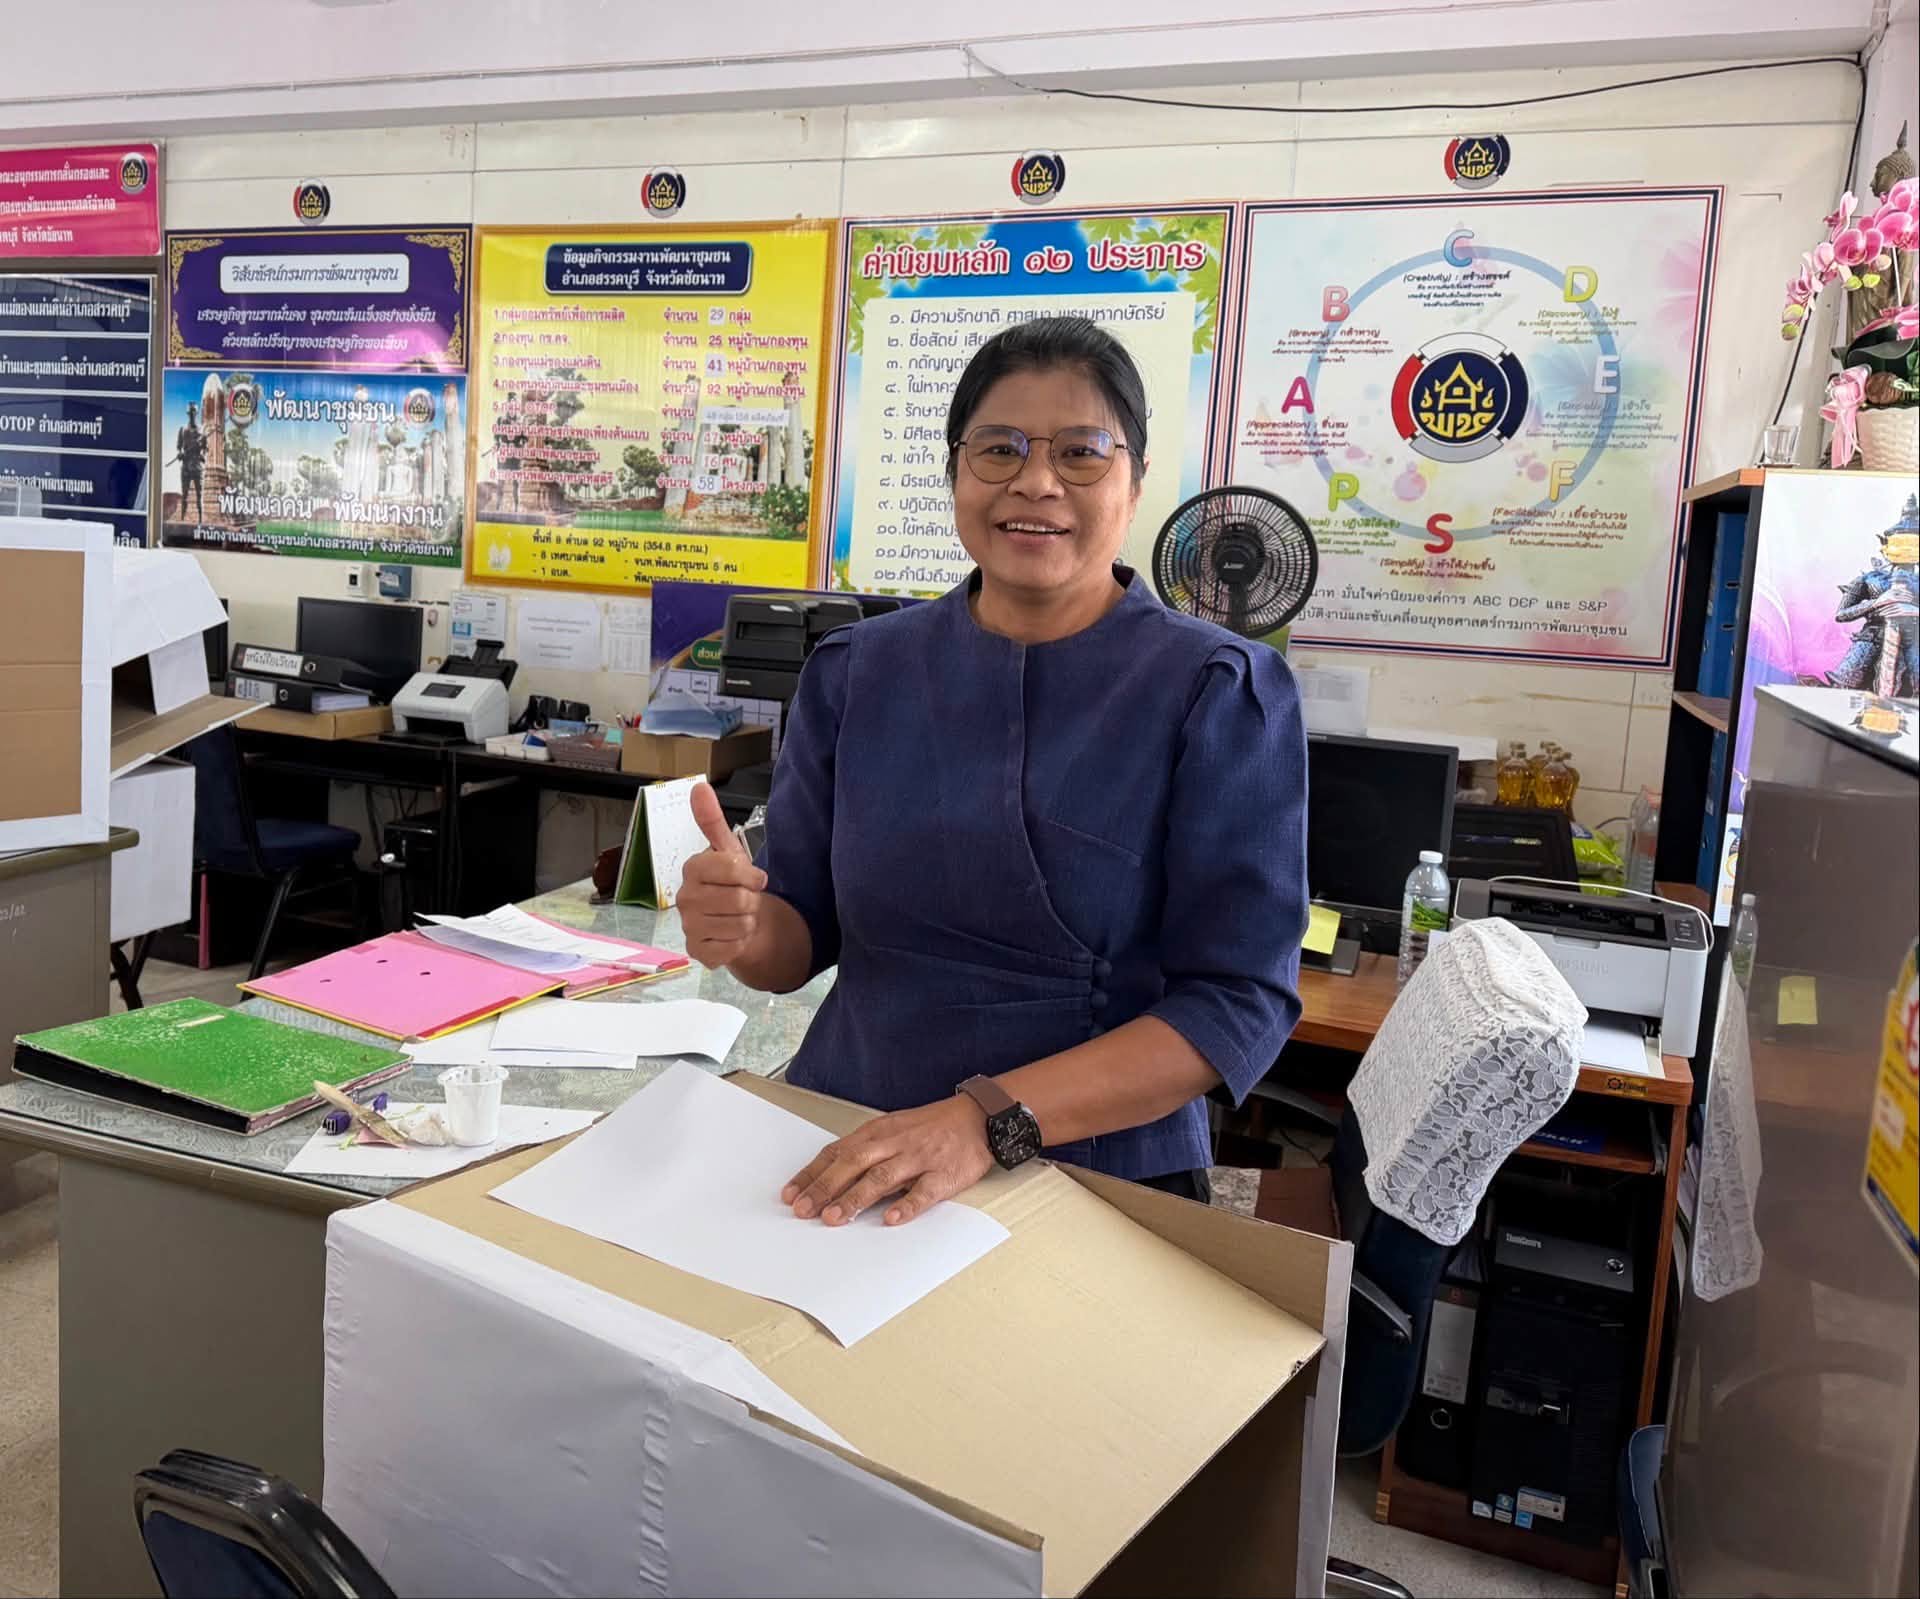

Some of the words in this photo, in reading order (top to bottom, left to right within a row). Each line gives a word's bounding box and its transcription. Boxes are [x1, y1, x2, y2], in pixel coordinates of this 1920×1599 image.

[563, 248, 731, 270] ข้อมูลกิจกรรมงานพัฒนาชุมชน
[863, 241, 1010, 278] ค่านิยมหลัก
[1024, 249, 1072, 273] ๑๒
[1088, 239, 1206, 270] ประการ
[1443, 228, 1475, 268] C
[232, 264, 399, 286] วิสัยทัศน์กรมการพัฒนาชุมชน
[562, 271, 639, 289] อำเภอสรรคบุรี
[646, 272, 726, 287] จังหวัดชัยนาท
[1563, 265, 1598, 303] D
[664, 307, 699, 321] จำนวน
[710, 308, 725, 321] 29
[729, 308, 752, 327] กลุ่ม
[910, 308, 1000, 323] มีความรักชาติ
[1322, 285, 1350, 322] B
[663, 331, 698, 346] จำนวน
[909, 328, 959, 347] ซื่อสัตย์
[707, 358, 723, 371] 41
[1593, 354, 1620, 394] E
[1281, 376, 1315, 414] A
[0, 415, 35, 431] OTOP
[265, 391, 396, 434] พัฒนาชุมชน
[697, 476, 715, 490] 58
[1328, 472, 1360, 512] P
[1550, 460, 1577, 502] F
[218, 488, 313, 520] พัฒนาคน
[333, 494, 444, 529] พัฒนางาน
[1424, 513, 1455, 554] S
[1473, 595, 1502, 607] ABC
[1577, 600, 1608, 612] S&P
